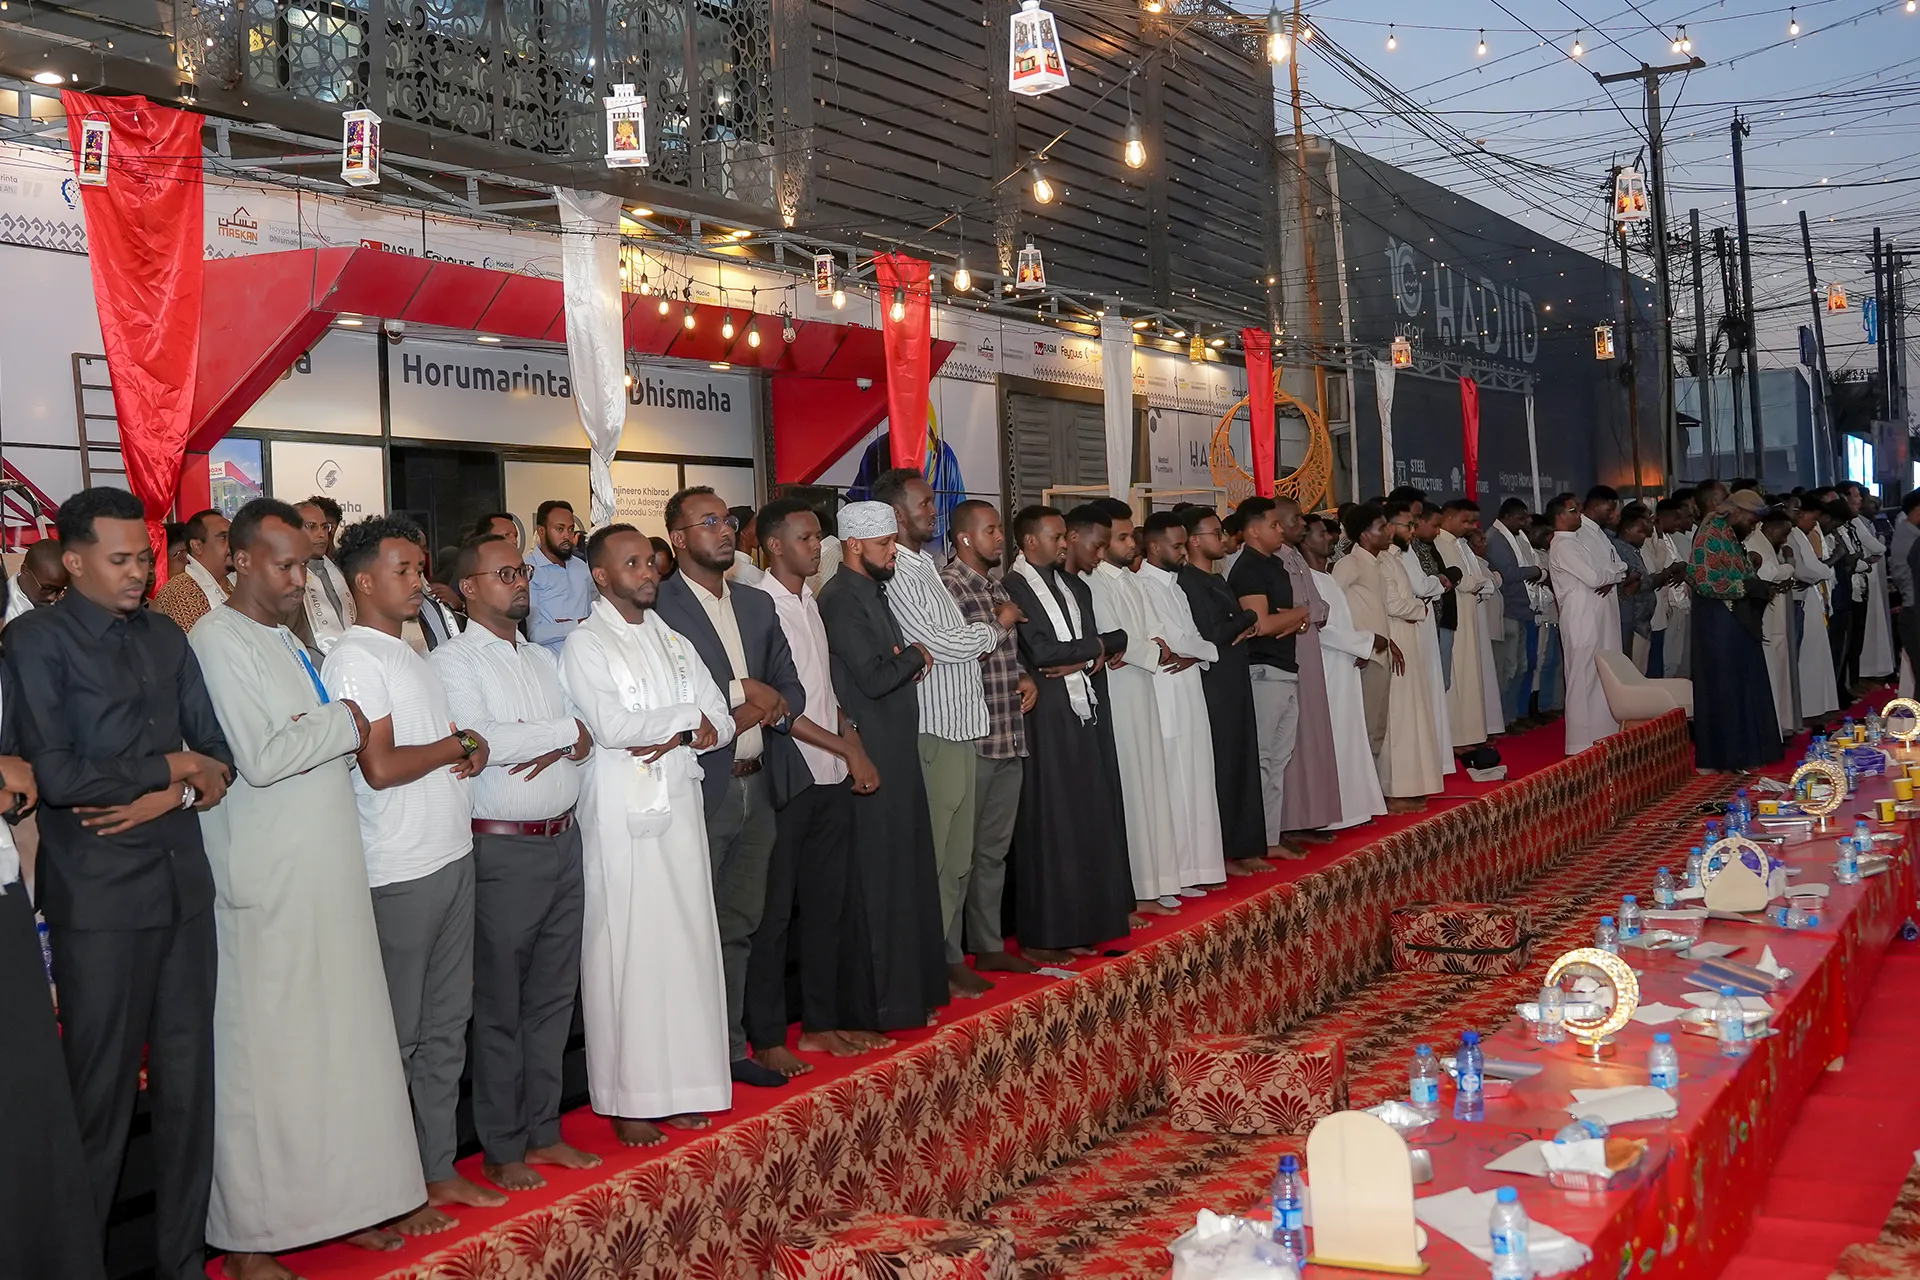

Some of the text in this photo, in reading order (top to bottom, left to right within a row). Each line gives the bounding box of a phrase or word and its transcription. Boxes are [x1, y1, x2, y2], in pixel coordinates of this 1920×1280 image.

[218, 226, 258, 242] MASKAN
[1433, 260, 1538, 364] HADIID
[402, 353, 571, 399] Horumarinta
[629, 376, 731, 413] Dhismaha
[1410, 459, 1426, 473] STEEL
[614, 486, 641, 496] njineero
[1410, 477, 1443, 492] STRUCTURE
